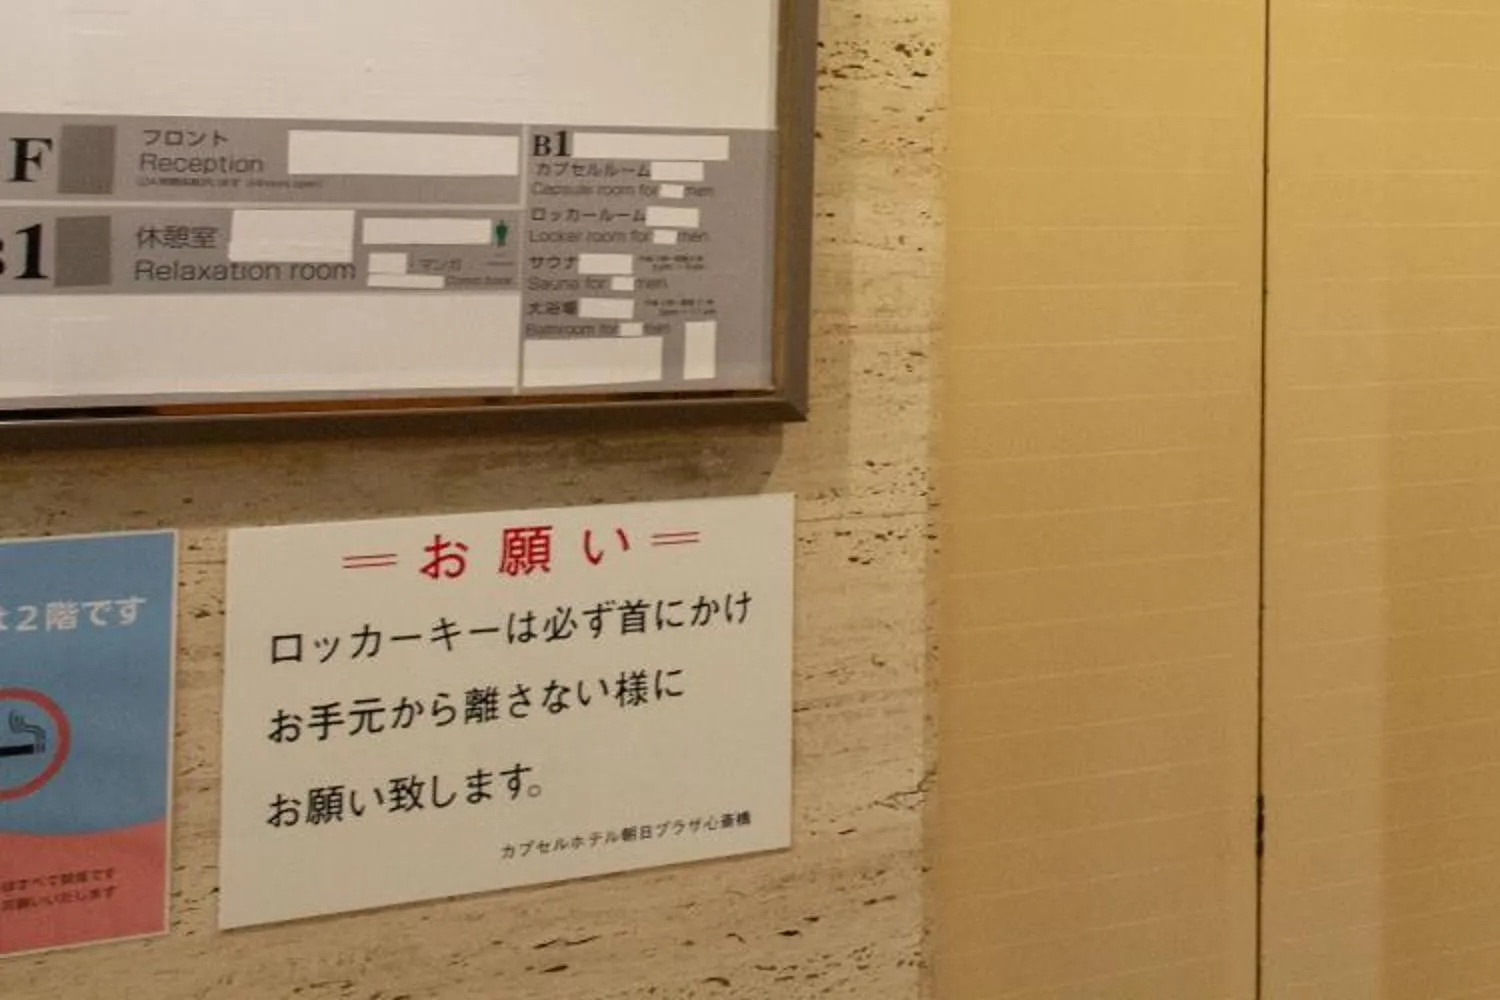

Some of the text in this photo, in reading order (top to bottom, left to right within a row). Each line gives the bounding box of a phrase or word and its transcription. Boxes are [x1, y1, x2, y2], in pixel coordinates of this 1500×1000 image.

[143, 129, 229, 147] フロント
[533, 130, 570, 157] B1
[138, 152, 264, 176] Reception
[136, 225, 218, 250] 休憩室
[0, 223, 48, 280] 1
[528, 256, 579, 270] サウナ
[134, 259, 356, 282] Relaxation room
[270, 591, 752, 664] ロッカーキーは必ず首にかけ
[267, 668, 685, 744] お手元から離さない様に
[265, 762, 542, 829] お願い致します。
